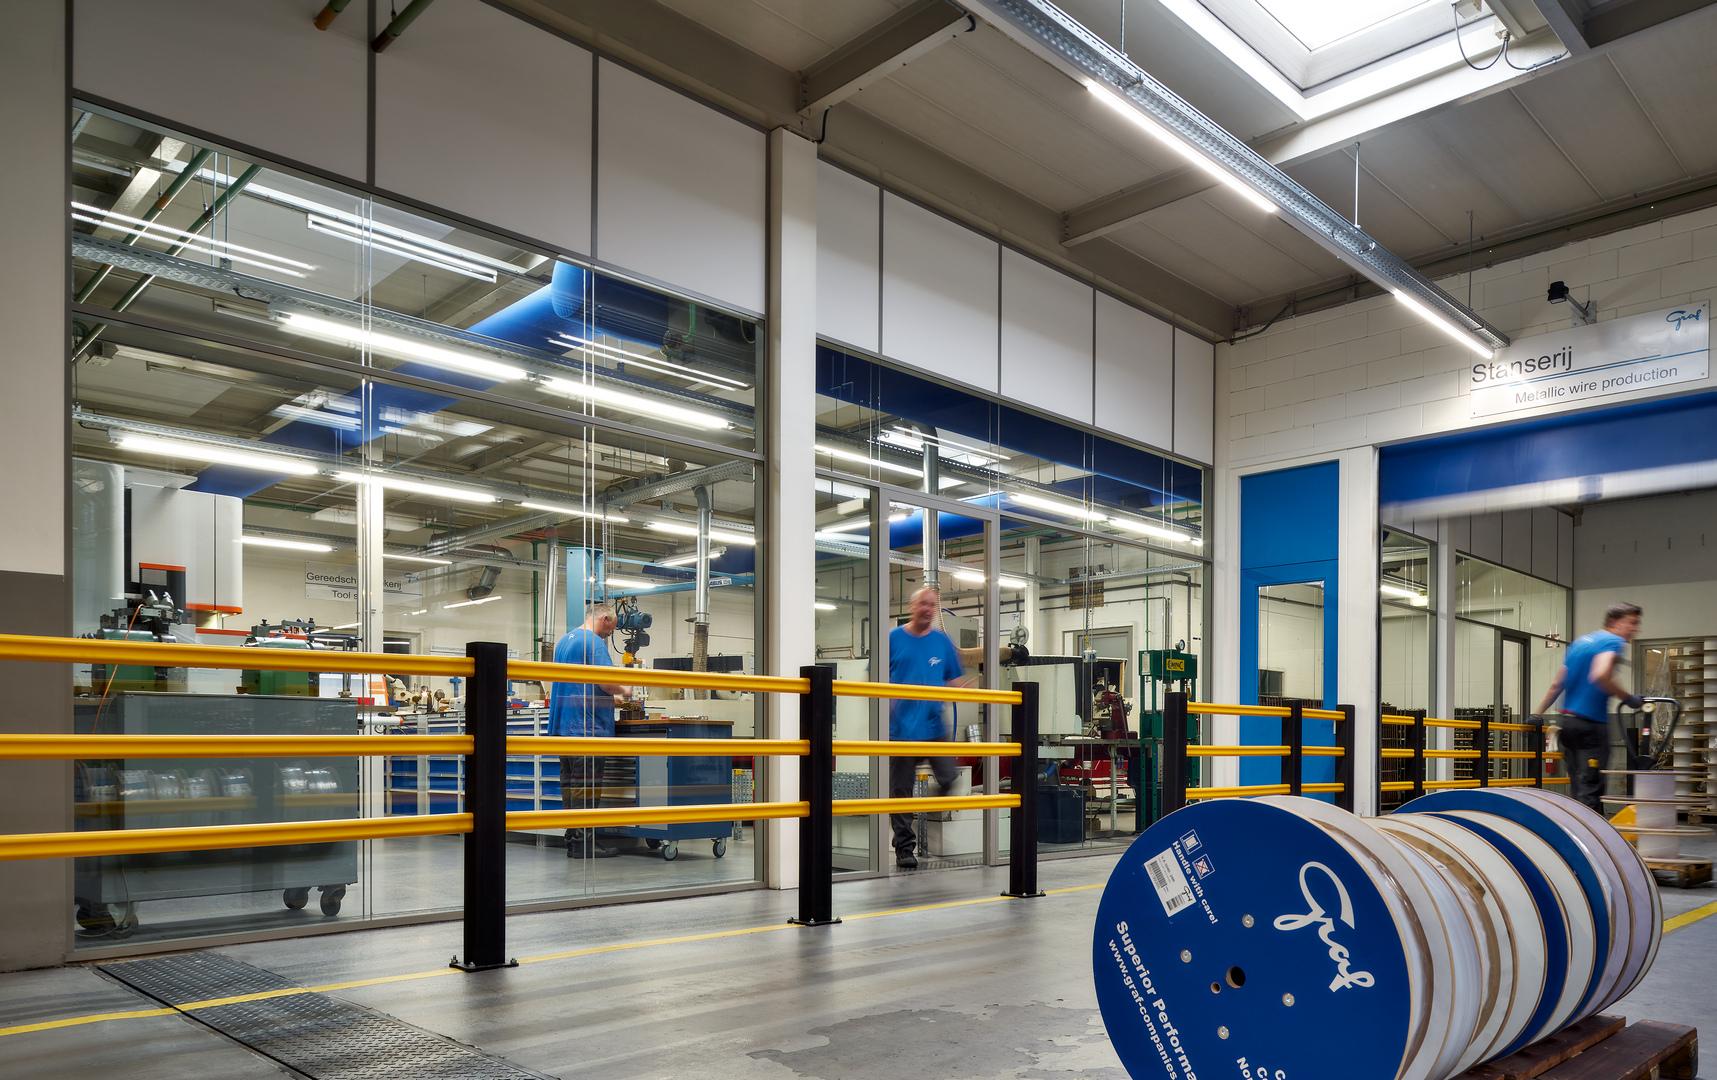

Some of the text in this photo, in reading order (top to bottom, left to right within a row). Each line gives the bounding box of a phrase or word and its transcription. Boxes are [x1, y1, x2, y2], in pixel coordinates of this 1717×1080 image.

[1665, 309, 1702, 331] Graf
[1472, 346, 1572, 383] Stanserij
[1515, 366, 1678, 405] Metallic wire production
[332, 589, 351, 599] Tool
[1172, 840, 1192, 875] Handle
[1190, 875, 1204, 897] with
[1201, 899, 1219, 924] care!
[1273, 861, 1376, 993] Graf
[1116, 920, 1157, 996] Superior
